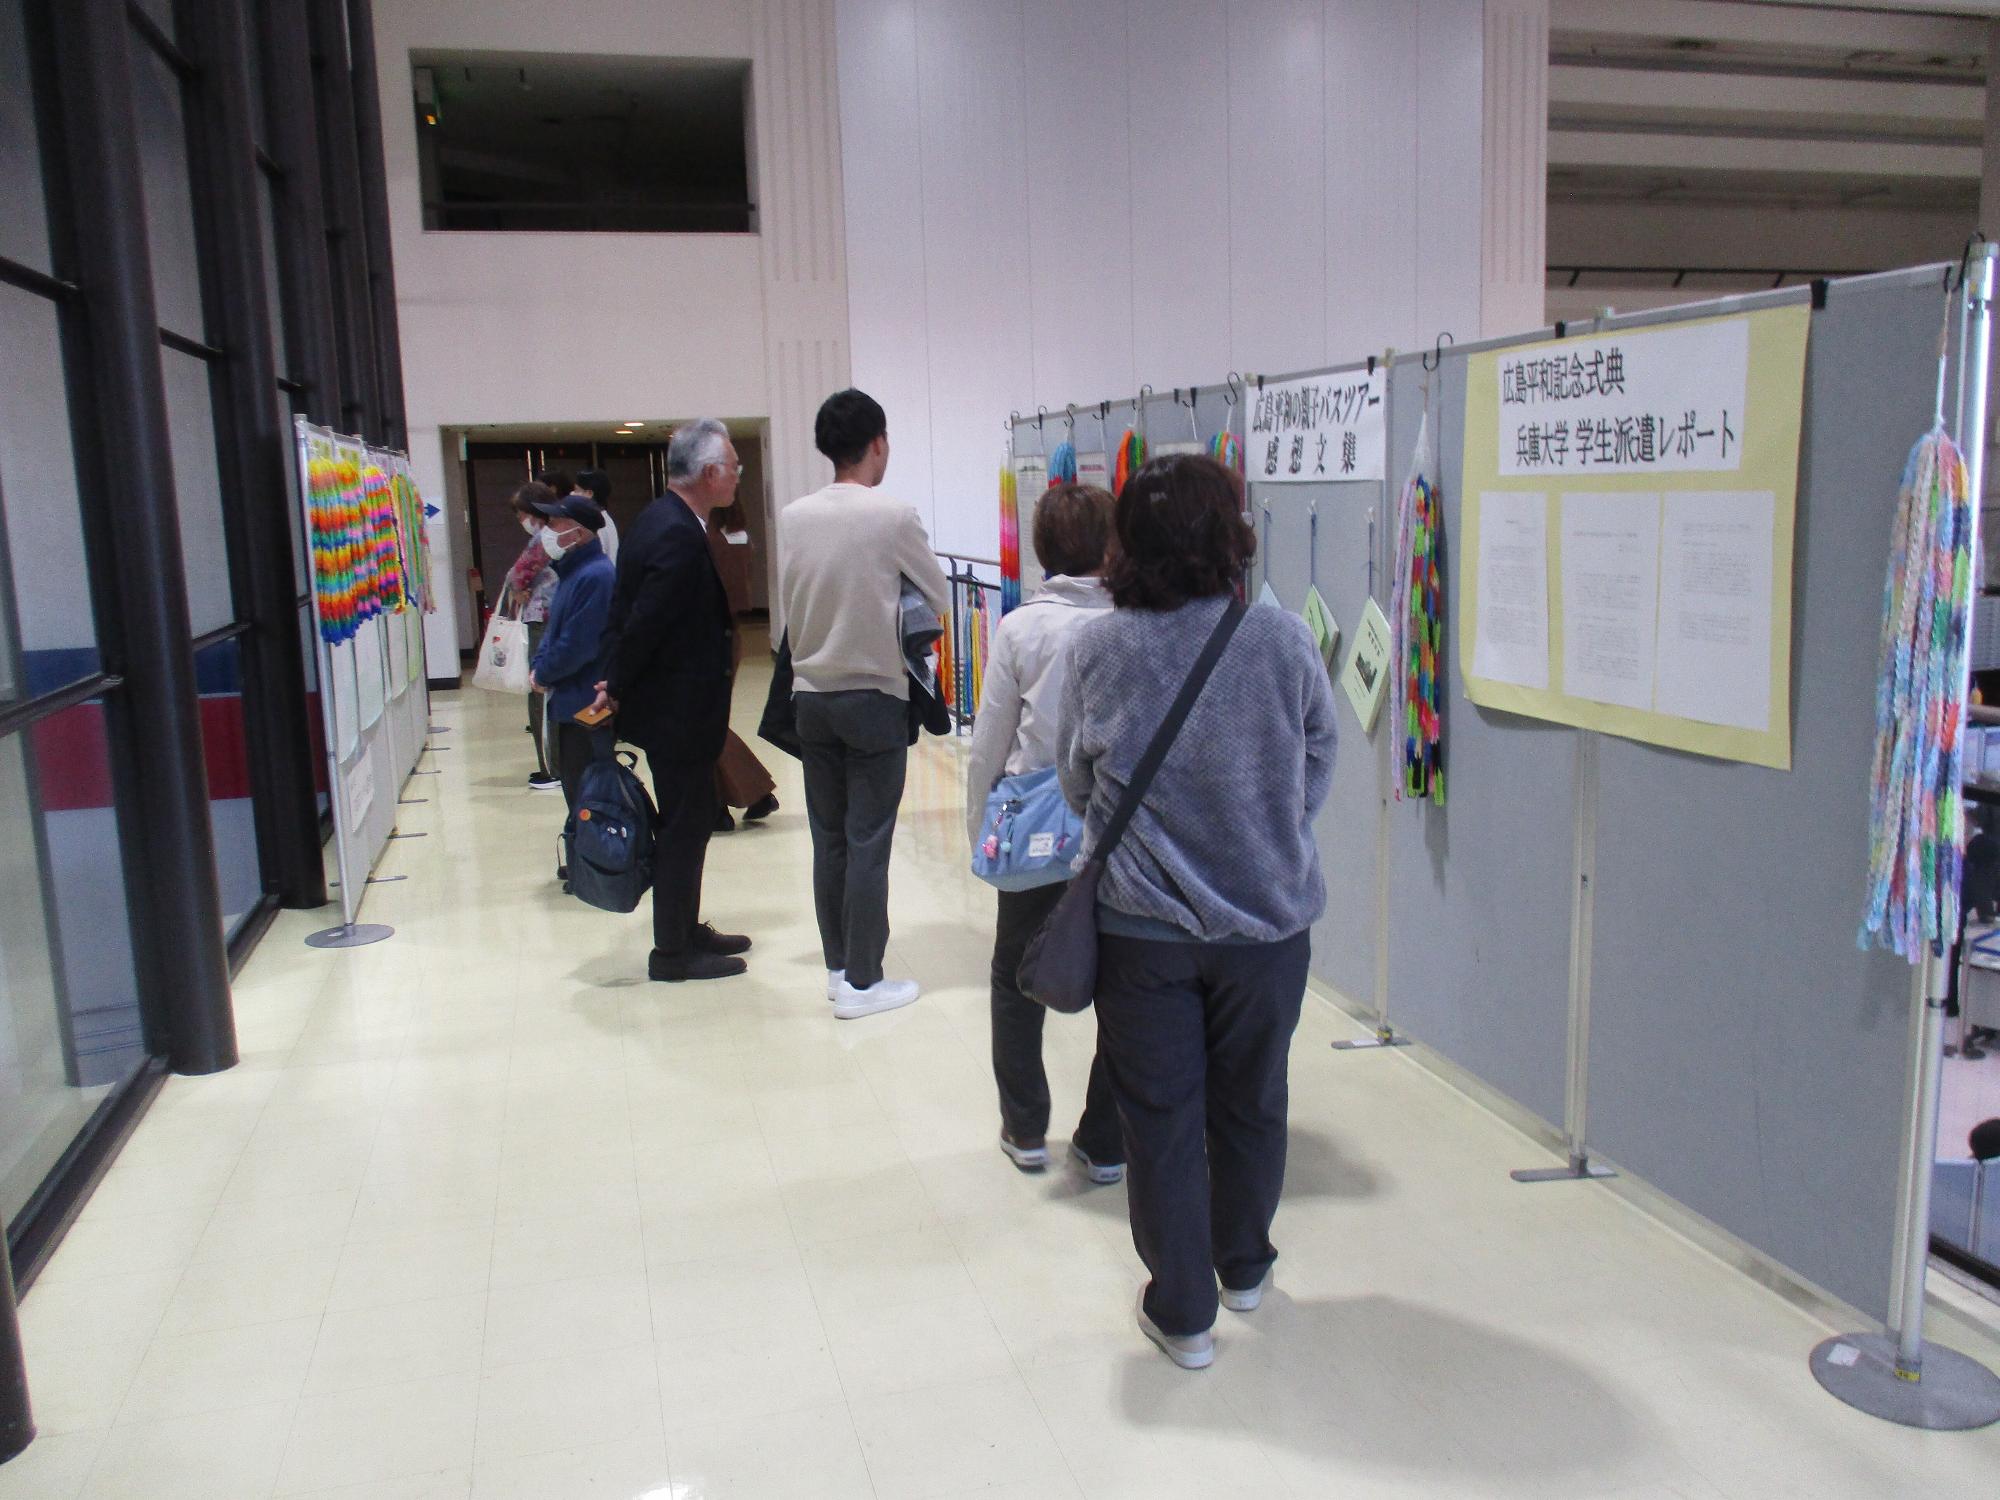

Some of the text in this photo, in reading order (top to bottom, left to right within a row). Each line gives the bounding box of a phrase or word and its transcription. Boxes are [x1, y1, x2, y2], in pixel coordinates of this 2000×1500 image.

[1502, 347, 1625, 406] 広島平和記念式典
[1516, 409, 1734, 467] 兵庫大学 学生派遣レポート
